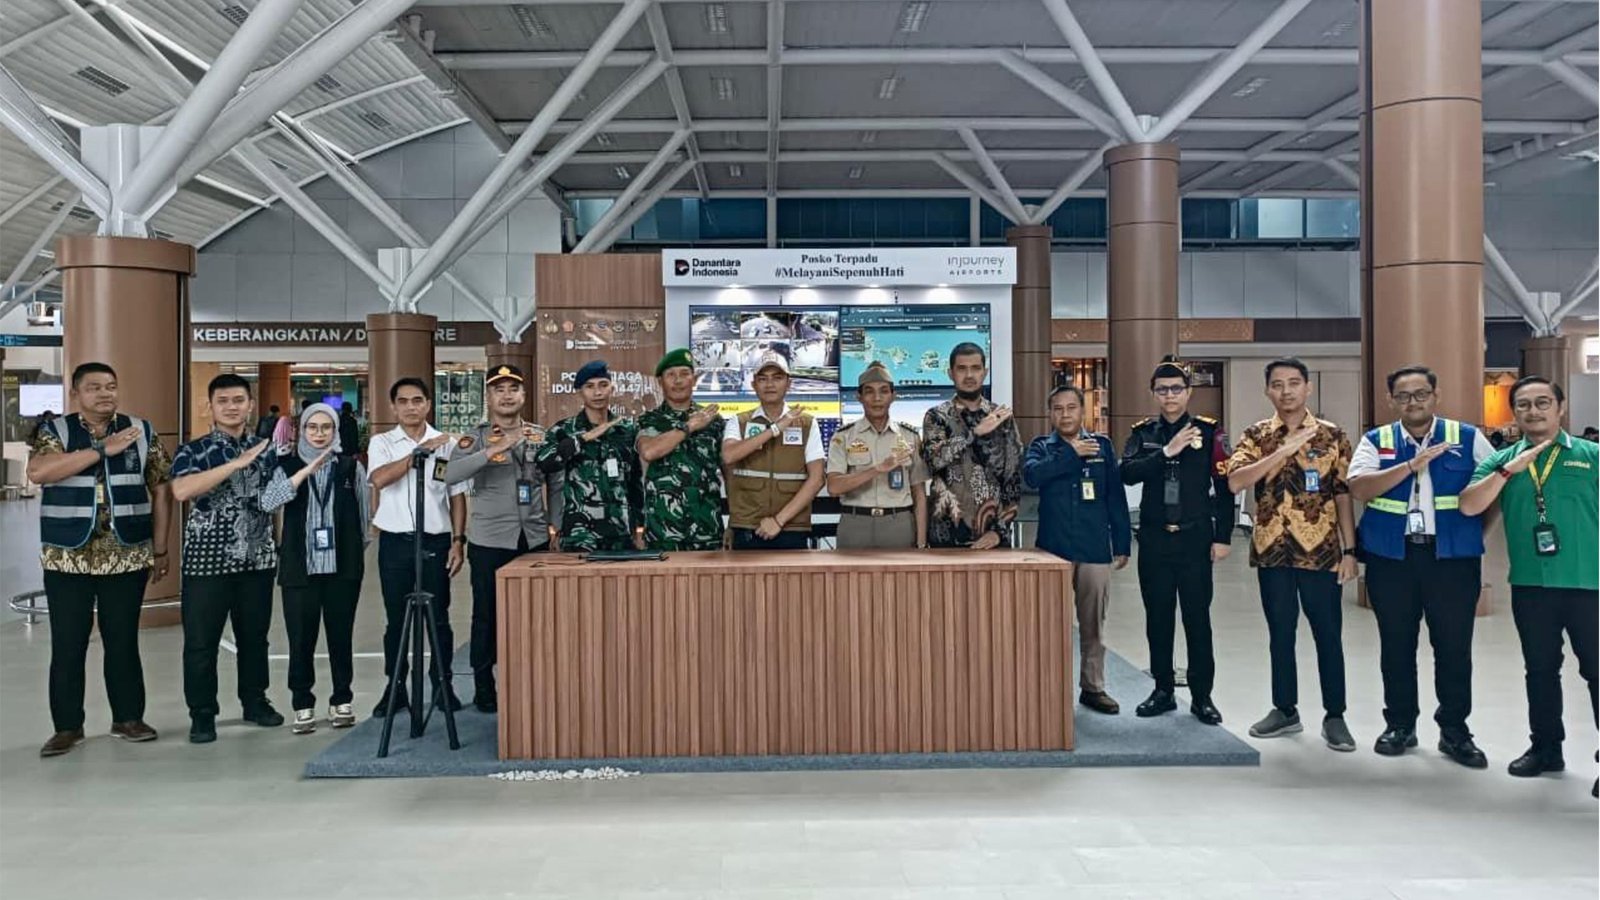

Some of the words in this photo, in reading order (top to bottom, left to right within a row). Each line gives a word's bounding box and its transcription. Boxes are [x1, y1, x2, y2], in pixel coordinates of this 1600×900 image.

[692, 258, 741, 267] Danantara
[801, 254, 832, 263] Posko
[834, 254, 879, 266] Terpadu
[692, 268, 738, 276] Indonesia
[775, 267, 904, 279] #MelayaniSepenuhHati
[194, 329, 340, 341] KEBERANGKATAN
[442, 392, 470, 401] ONE
[442, 404, 476, 413] STOP
